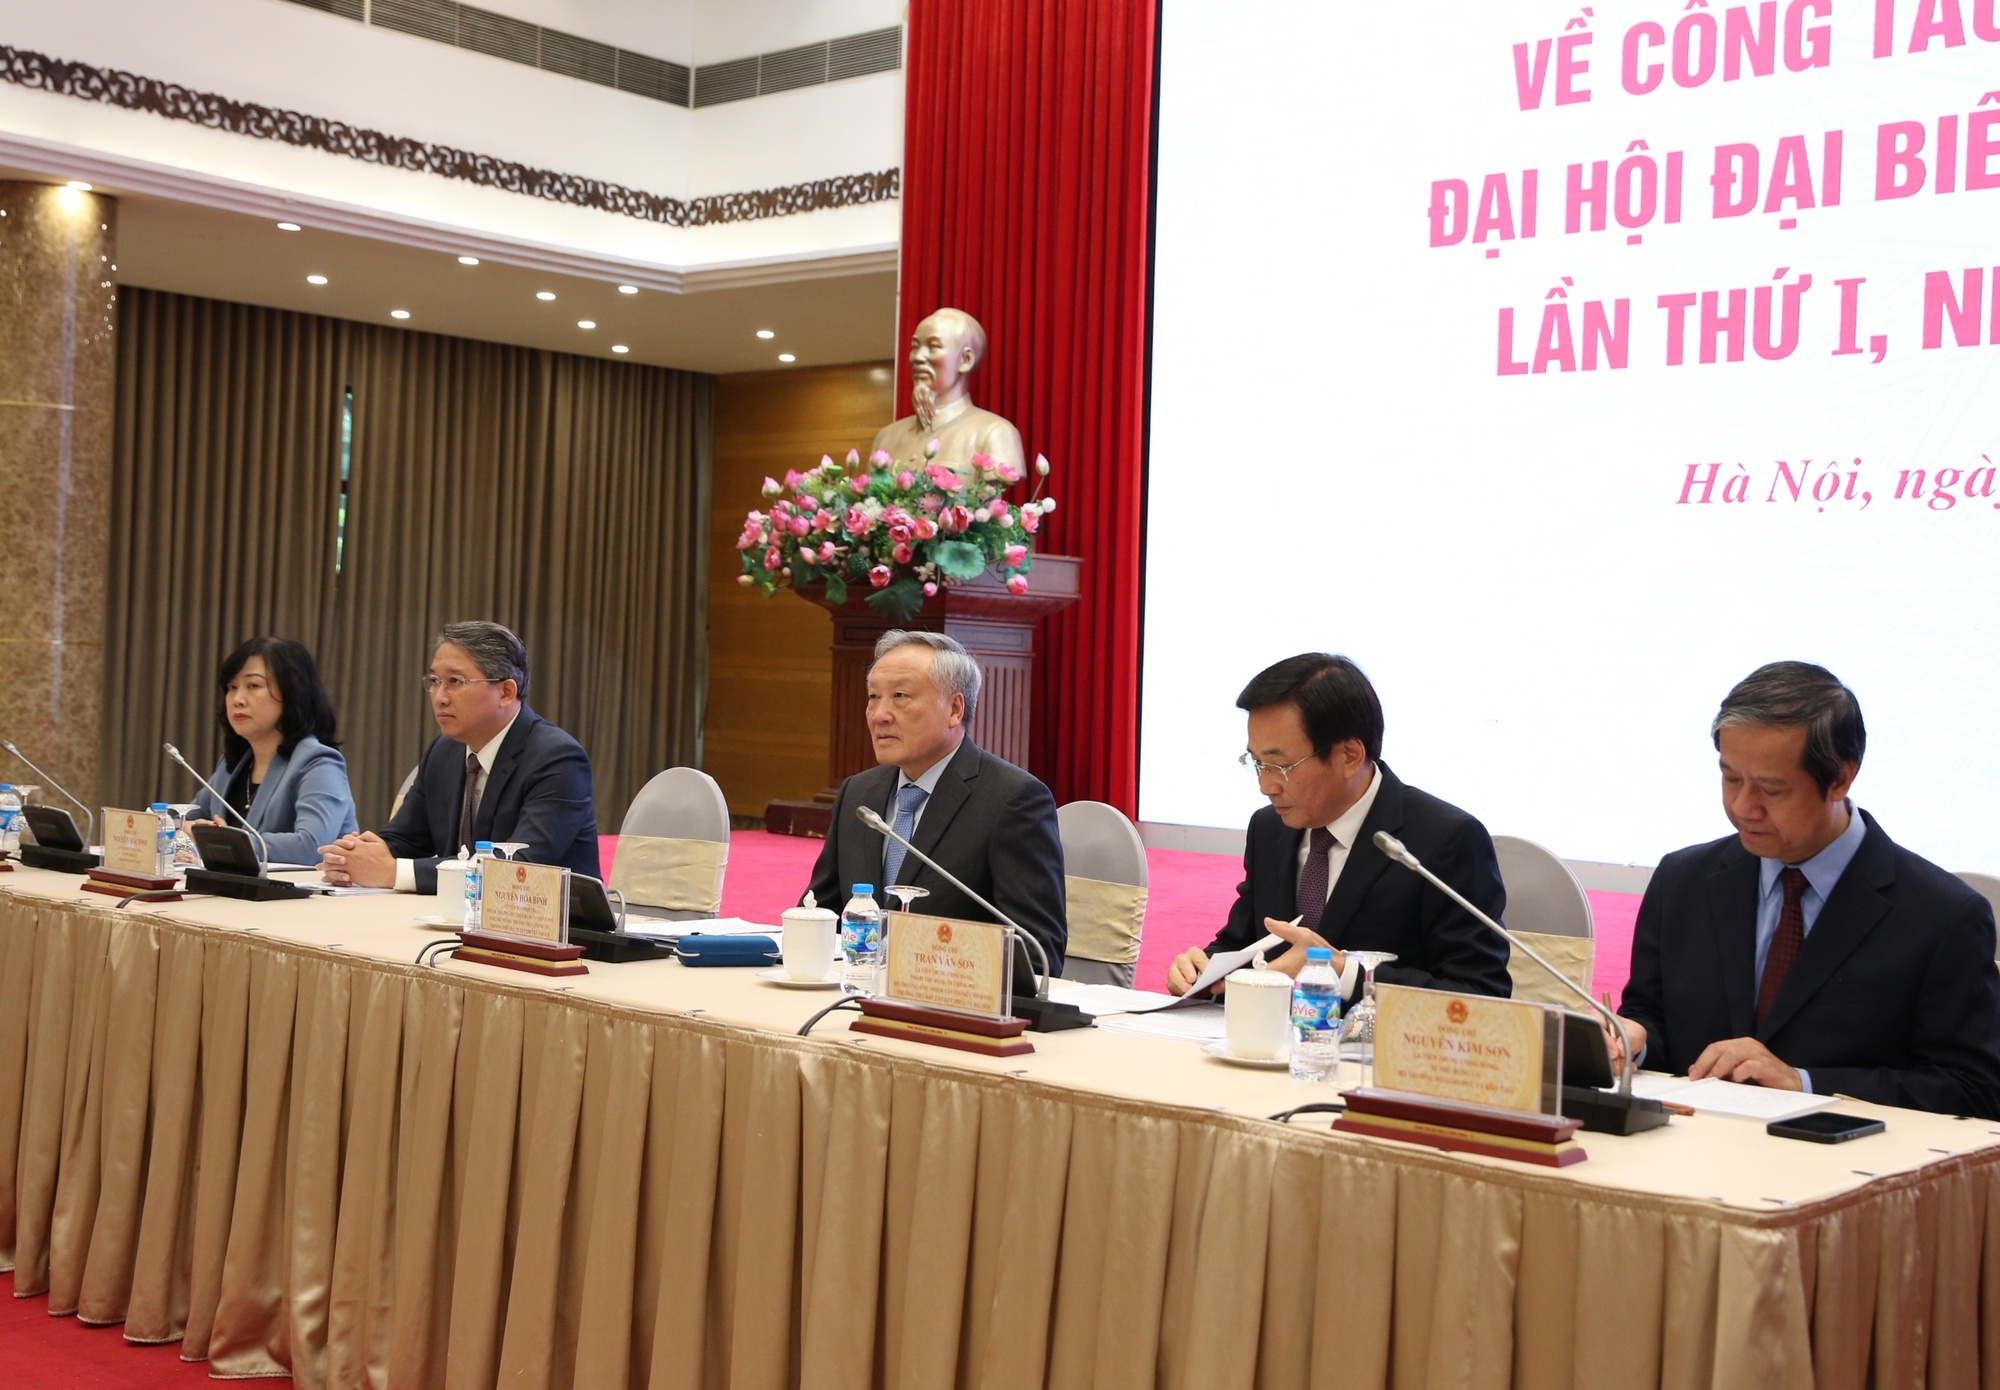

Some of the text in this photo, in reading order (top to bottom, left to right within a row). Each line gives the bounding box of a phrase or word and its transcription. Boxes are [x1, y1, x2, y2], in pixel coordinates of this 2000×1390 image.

[1512, 6, 1594, 111] VỀ
[1621, 0, 1832, 96] CÔNG
[1427, 168, 1539, 259] ĐẠI
[1564, 139, 1684, 246] HỘI
[1709, 129, 1843, 231] ĐẠI
[1496, 265, 2000, 377] LẦN THỨ I, N
[1675, 453, 2000, 513] Hà Nội, ngà
[1457, 1040, 1482, 1055] KIM
